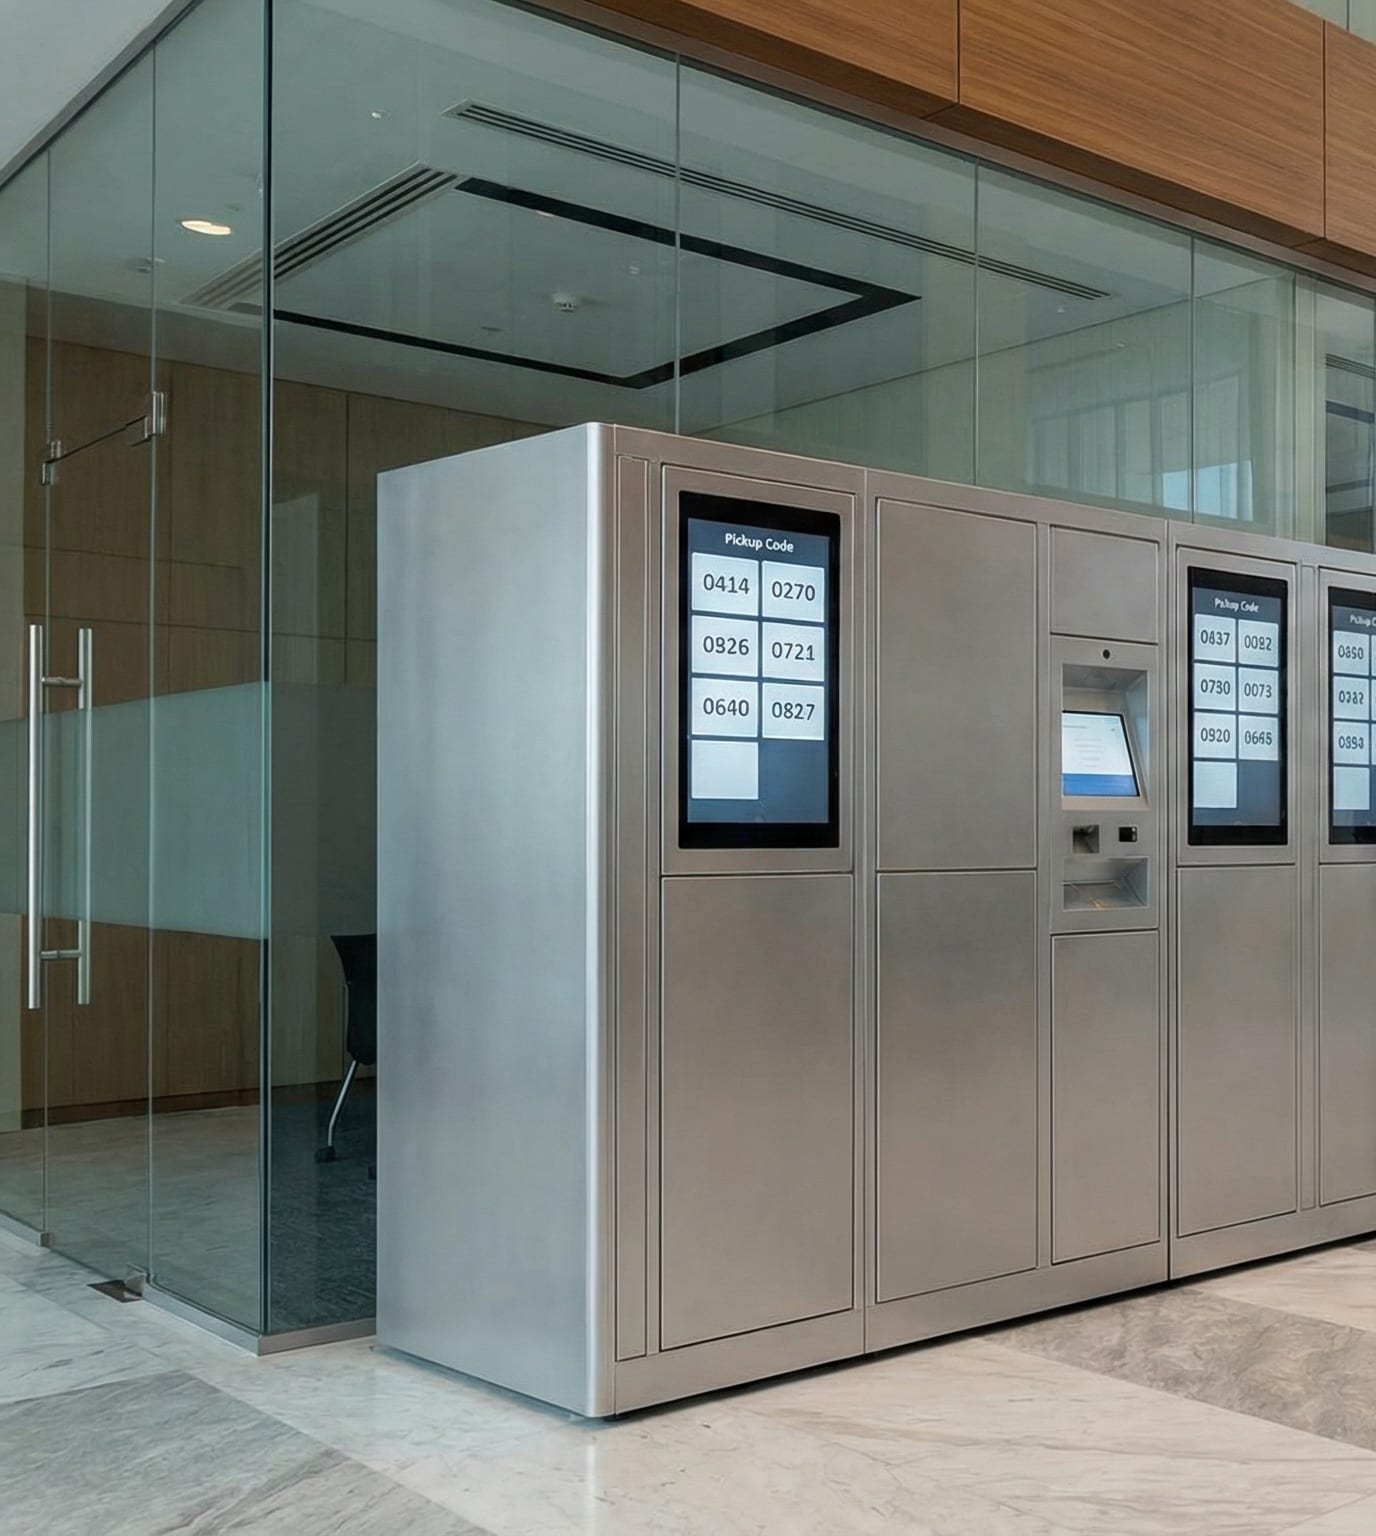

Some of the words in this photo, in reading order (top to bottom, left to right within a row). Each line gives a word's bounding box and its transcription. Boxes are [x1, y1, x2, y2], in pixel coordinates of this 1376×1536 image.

[725, 533, 762, 550] Pickup
[766, 539, 794, 552] Code
[704, 574, 749, 594] 0414
[772, 581, 815, 601] 0270
[772, 642, 814, 661] 0721
[1201, 679, 1230, 695] 0730
[1244, 683, 1272, 698] 0073
[703, 698, 749, 716] 0640
[772, 702, 815, 720] 0827
[1201, 728, 1230, 743] 0920
